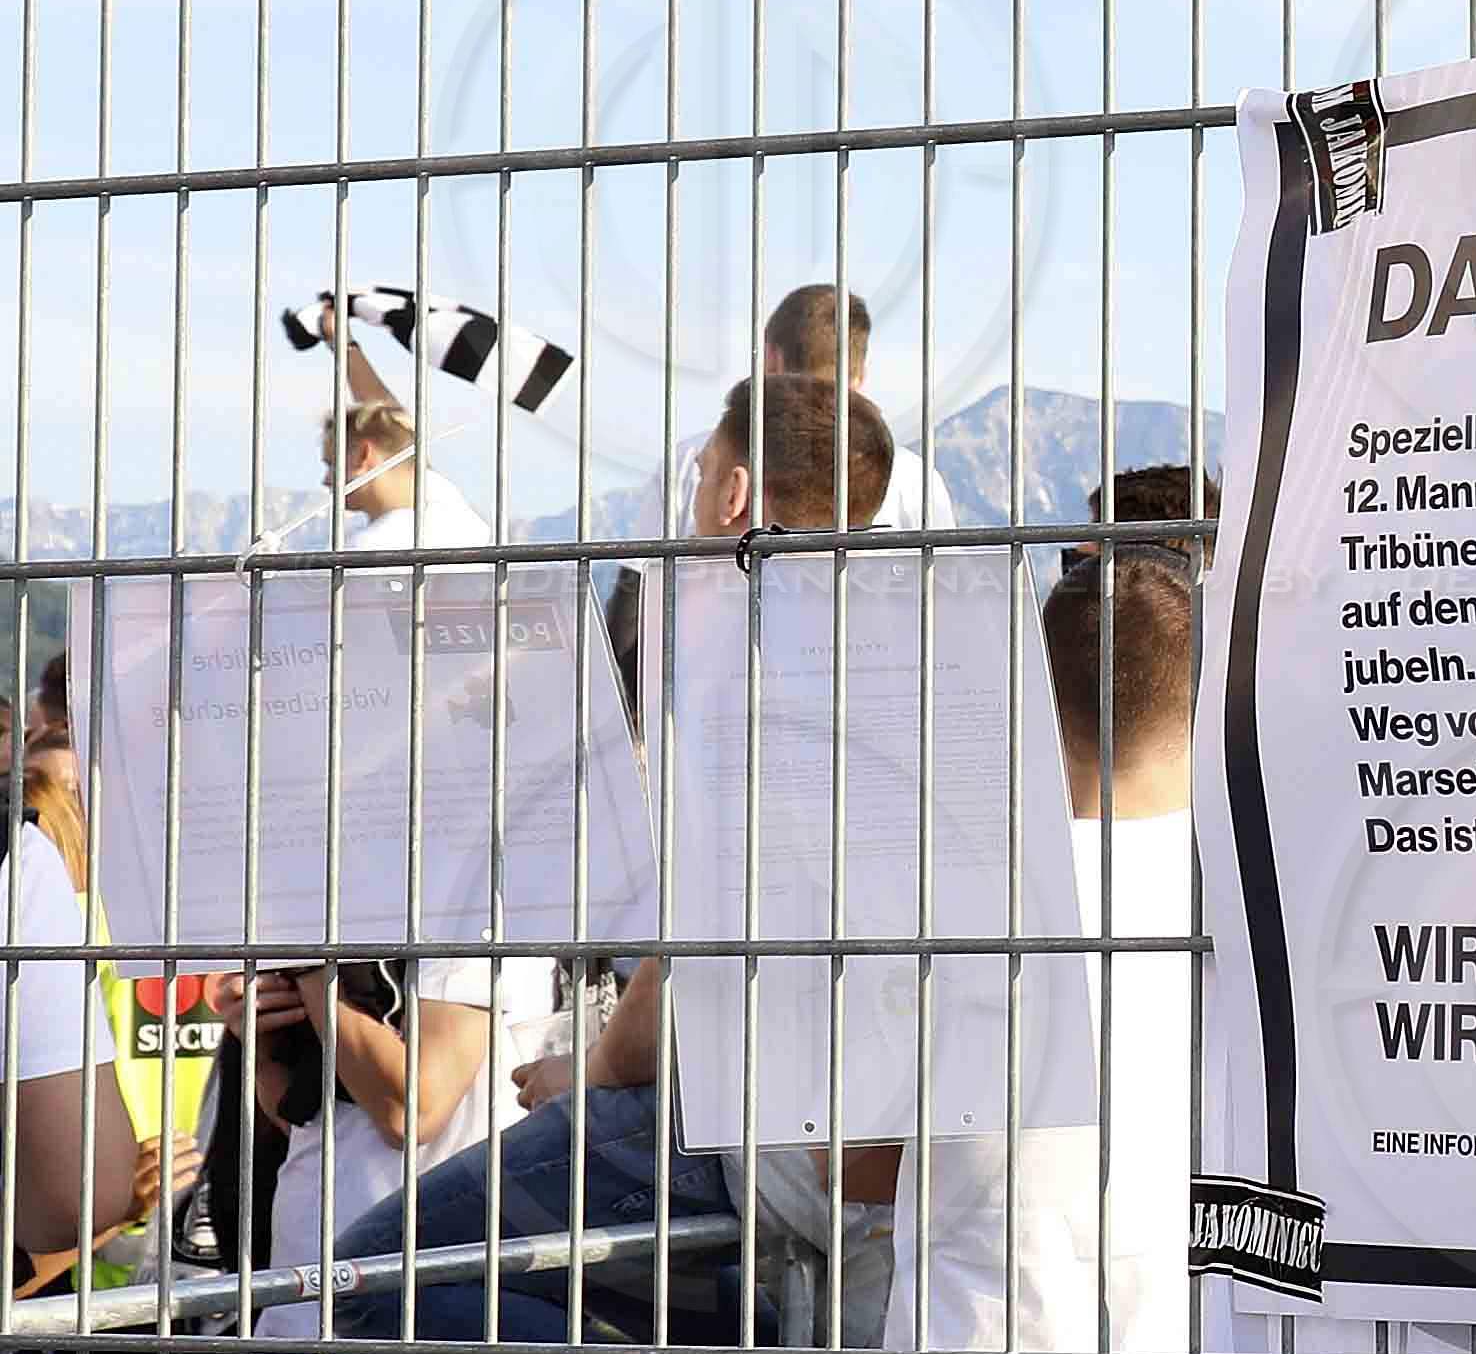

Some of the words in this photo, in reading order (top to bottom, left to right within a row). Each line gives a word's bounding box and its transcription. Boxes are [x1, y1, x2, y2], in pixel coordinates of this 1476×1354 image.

[1343, 478, 1388, 514] 12.
[1341, 591, 1402, 629] auf
[1343, 646, 1476, 694] jubeln.
[1347, 705, 1439, 747] Weg
[1365, 818, 1438, 853] Das
[1373, 1131, 1420, 1154] EINE
